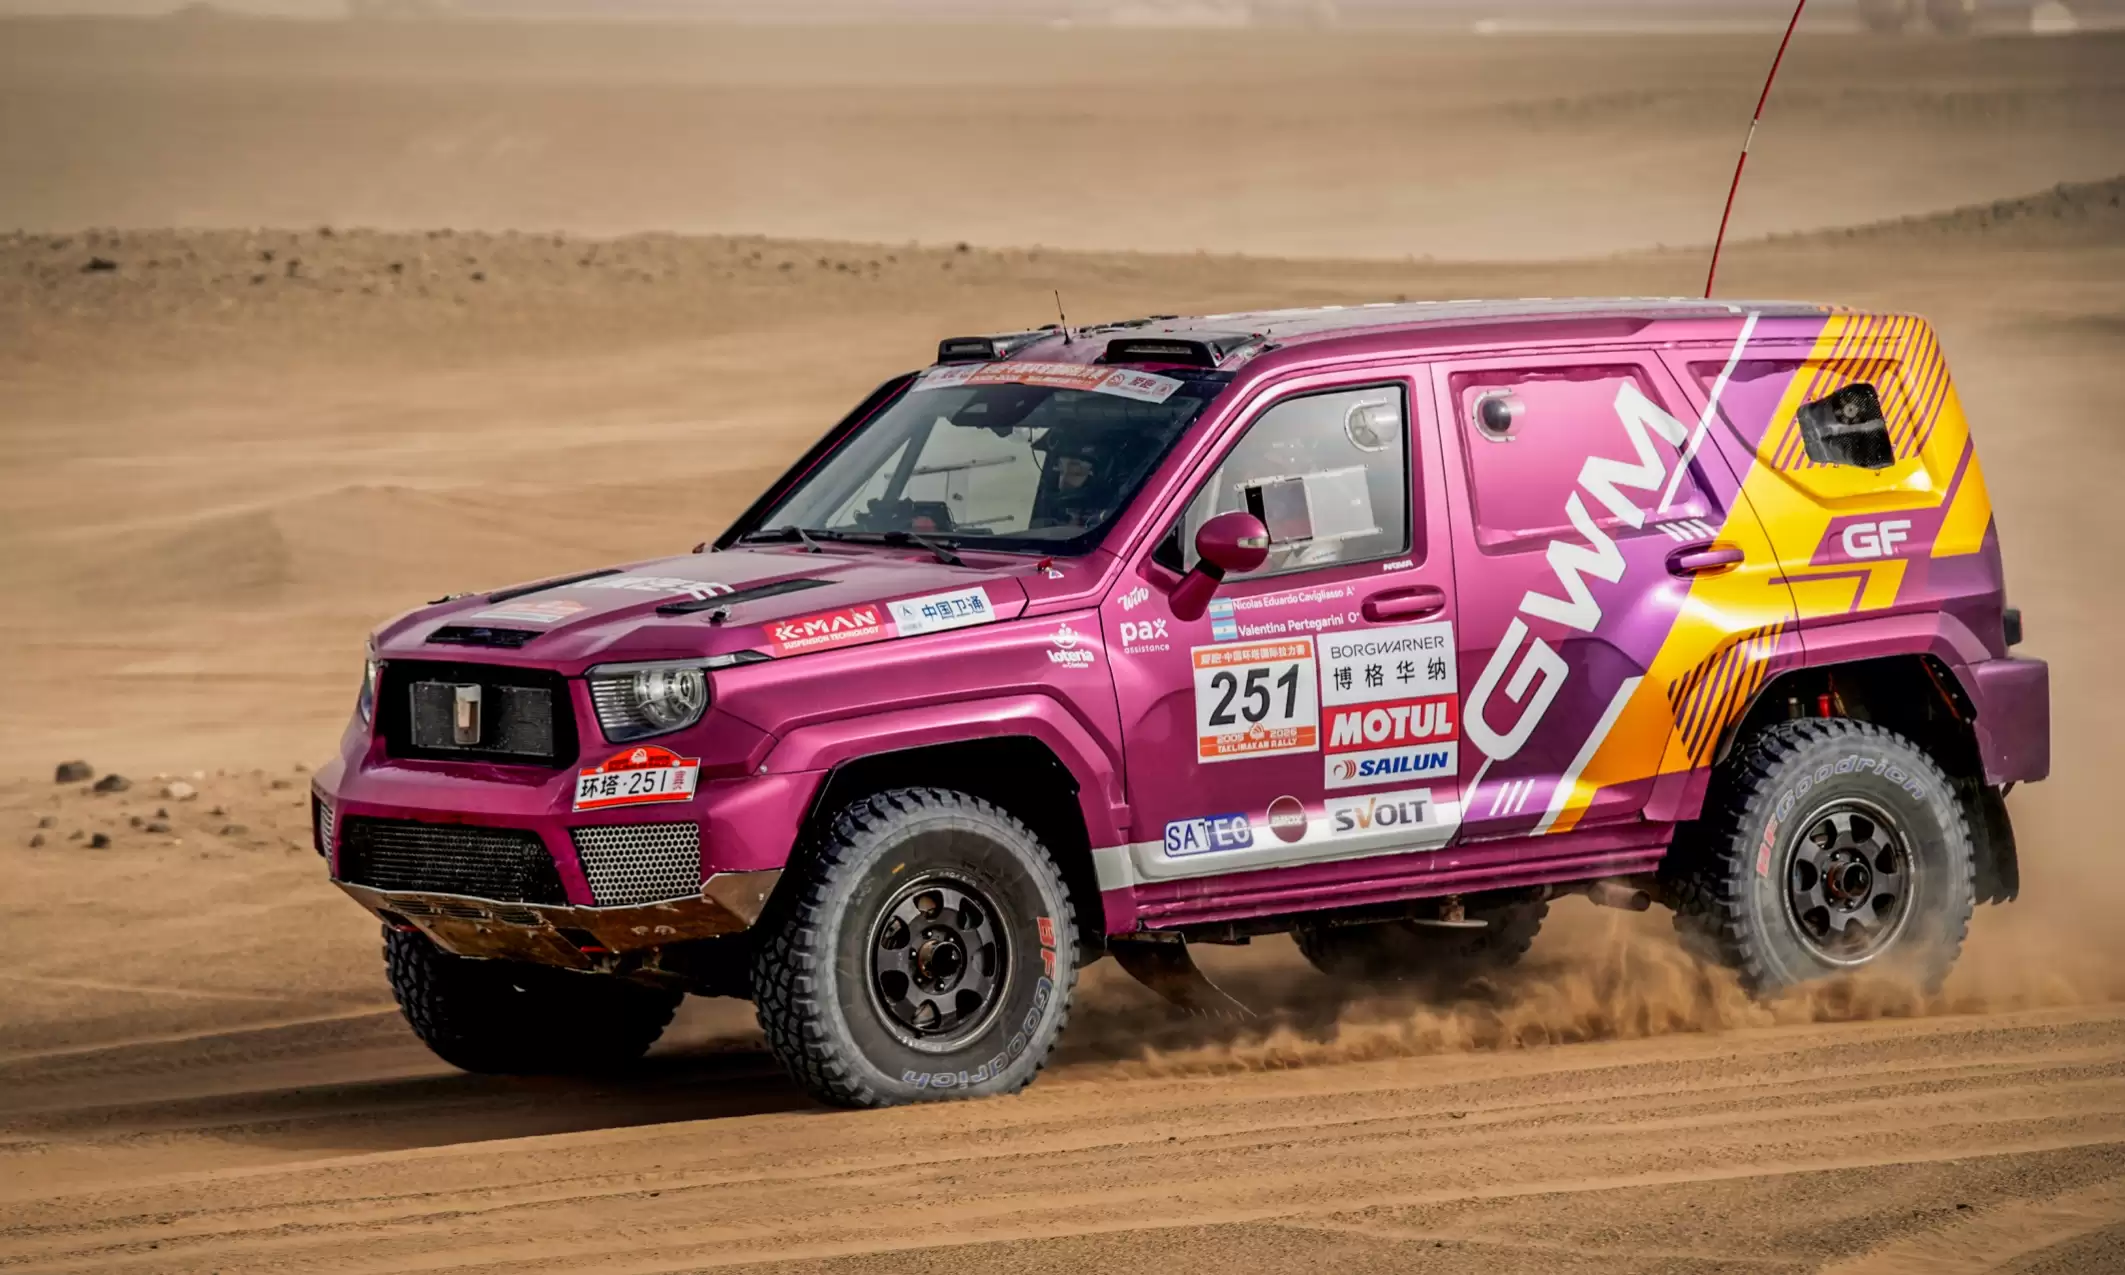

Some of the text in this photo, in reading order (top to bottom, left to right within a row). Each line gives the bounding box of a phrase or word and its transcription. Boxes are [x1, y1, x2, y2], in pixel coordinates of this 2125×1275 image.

[1842, 520, 1911, 558] GF
[1463, 381, 1688, 760] GWM
[921, 595, 986, 622] 中国卫通
[1263, 594, 1299, 608] Eduardo
[1299, 590, 1344, 604] Cavigliasso
[775, 609, 877, 641] K-MAN
[783, 625, 880, 650] SUSPENSION TECHNOLOGY
[1120, 618, 1169, 647] pax
[1238, 620, 1286, 637] Valentina
[1288, 613, 1344, 632] Pertegarini
[1124, 643, 1170, 655] assistance
[1330, 636, 1445, 660] BORGWARNER
[1333, 656, 1447, 692] 博格华纳
[1209, 664, 1299, 727] 251
[1329, 702, 1453, 747] MOTUL
[1271, 738, 1298, 749] RALLY
[1358, 752, 1449, 777] SAILUN
[1335, 797, 1427, 831] SVOLT
[1168, 816, 1250, 851] SATEO
